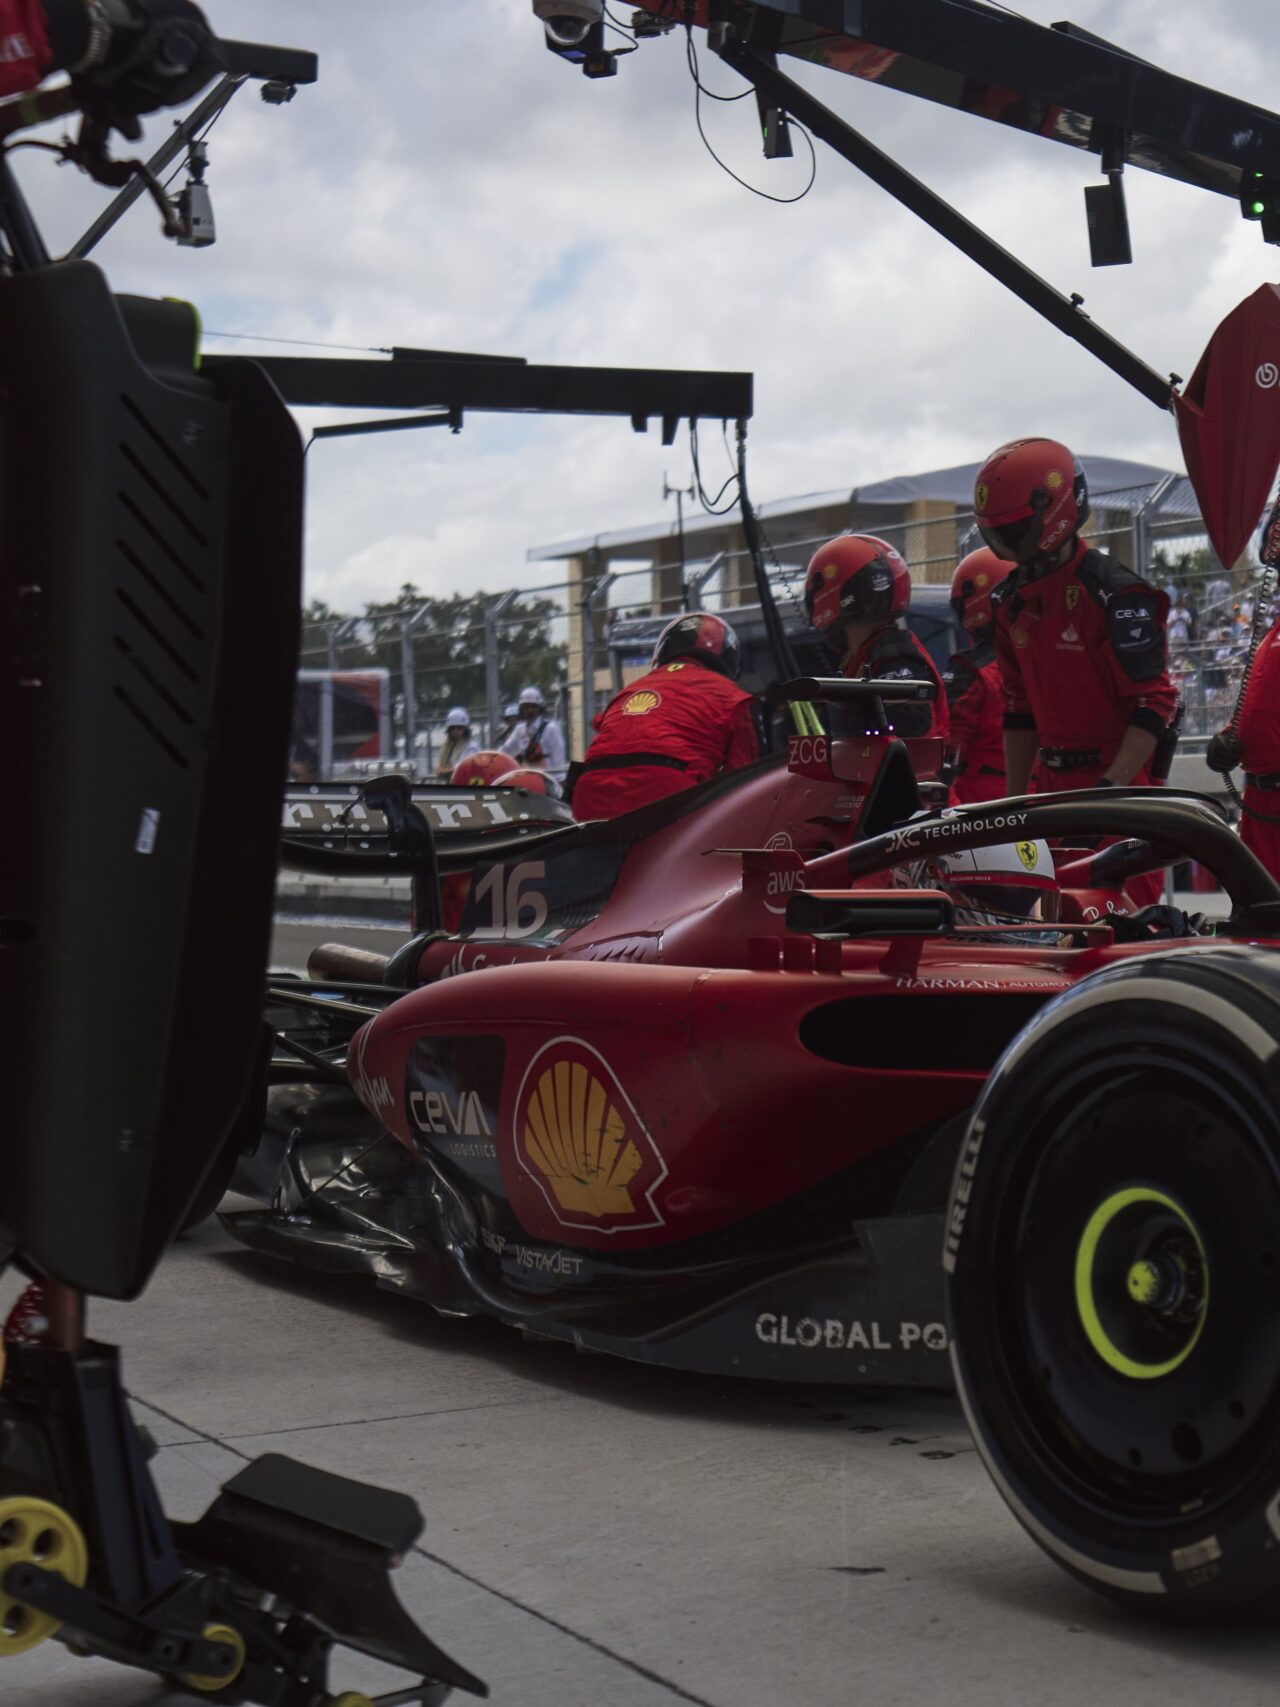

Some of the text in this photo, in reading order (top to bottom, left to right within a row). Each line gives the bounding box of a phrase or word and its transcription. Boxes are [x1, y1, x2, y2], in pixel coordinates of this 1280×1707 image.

[1115, 608, 1151, 619] CEVA
[788, 737, 828, 765] ZCG
[923, 813, 1028, 838] TECHNOLOGY
[767, 868, 806, 895] aws
[467, 860, 549, 939] 16
[896, 977, 1075, 989] HARMAN AUTOMOT
[409, 1089, 493, 1137] CEVA
[449, 1143, 497, 1159] LOGISTICS
[755, 1311, 948, 1351] GLOBAL PO
